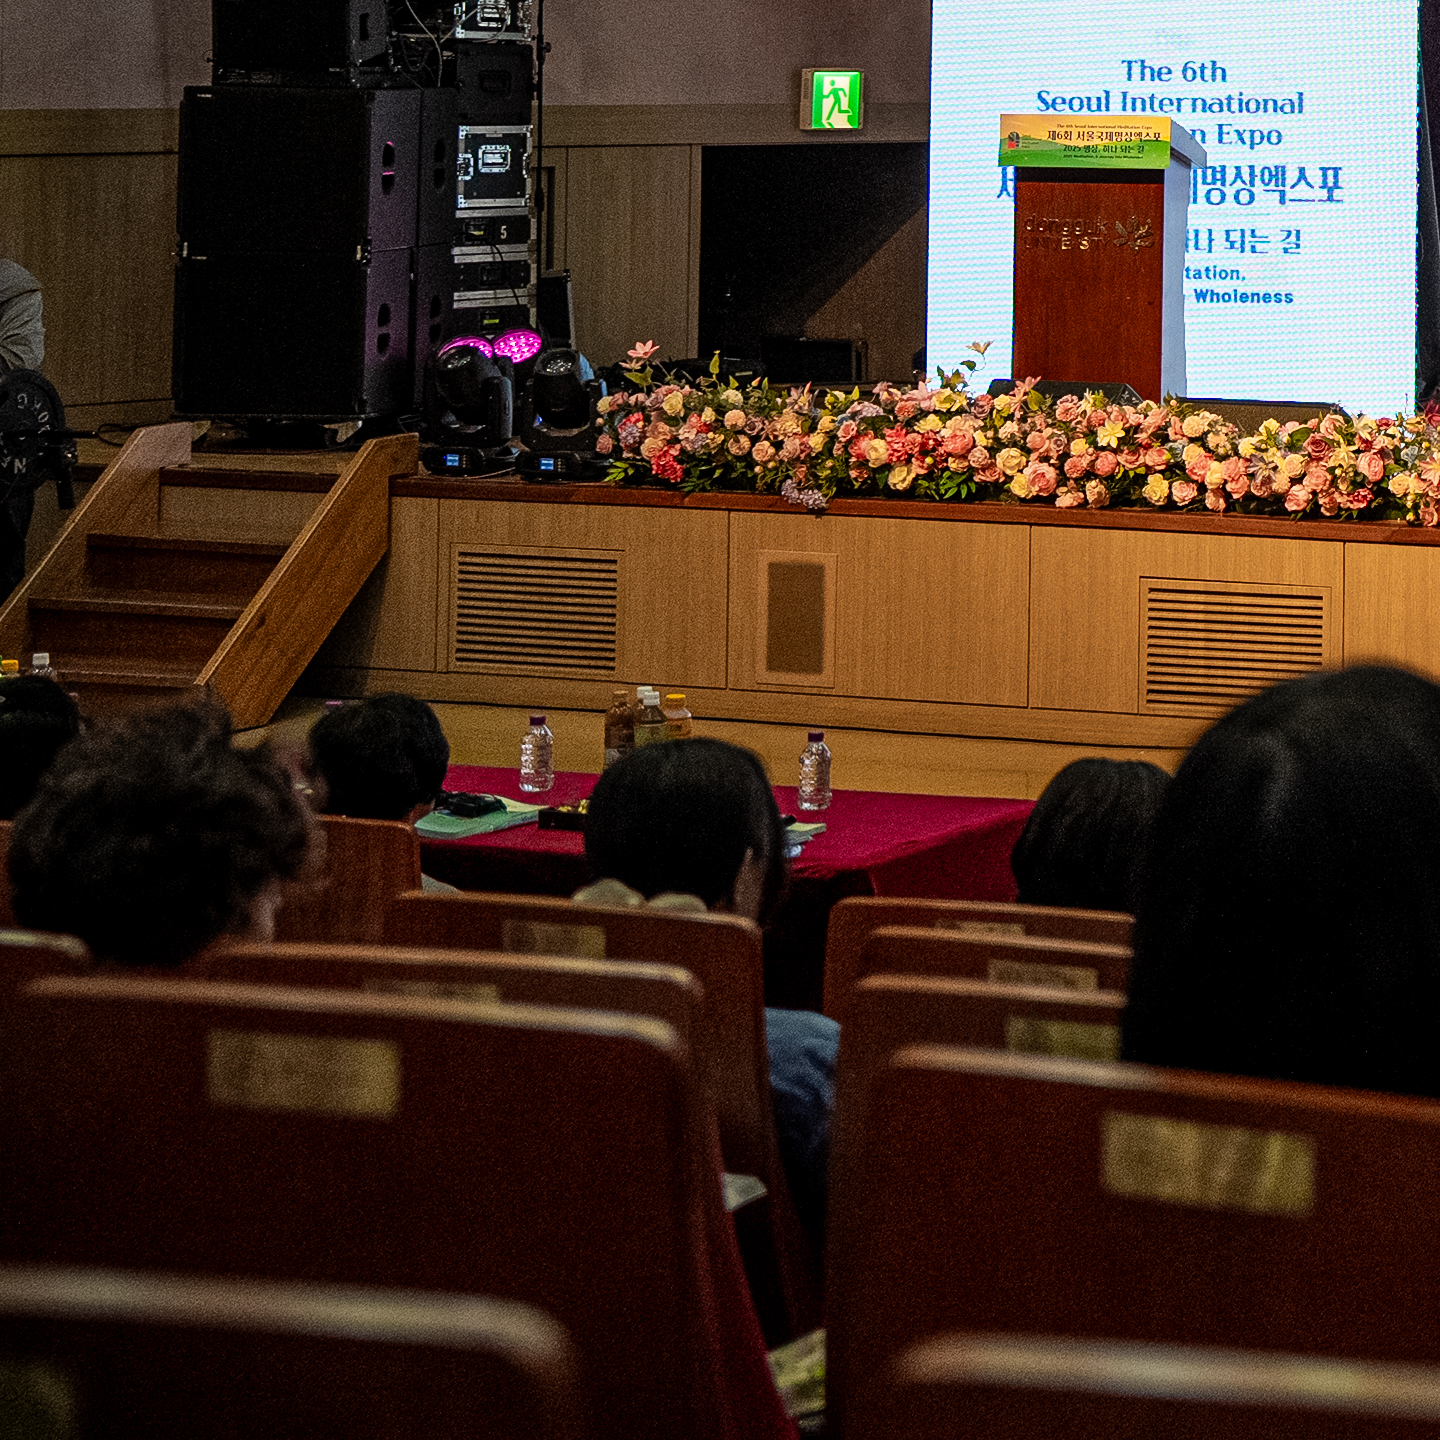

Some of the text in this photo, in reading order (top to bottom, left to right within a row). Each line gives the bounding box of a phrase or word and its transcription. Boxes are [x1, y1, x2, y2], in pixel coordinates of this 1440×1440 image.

[1121, 59, 1227, 83] The 6th
[1037, 90, 1304, 114] Seoul International
[1047, 131, 1161, 142] 제6회 서울국제명상엑스포
[1216, 124, 1283, 150] Expo
[500, 225, 507, 240] 5
[1224, 229, 1301, 254] 되는 길
[1193, 289, 1294, 304] Wholeness
